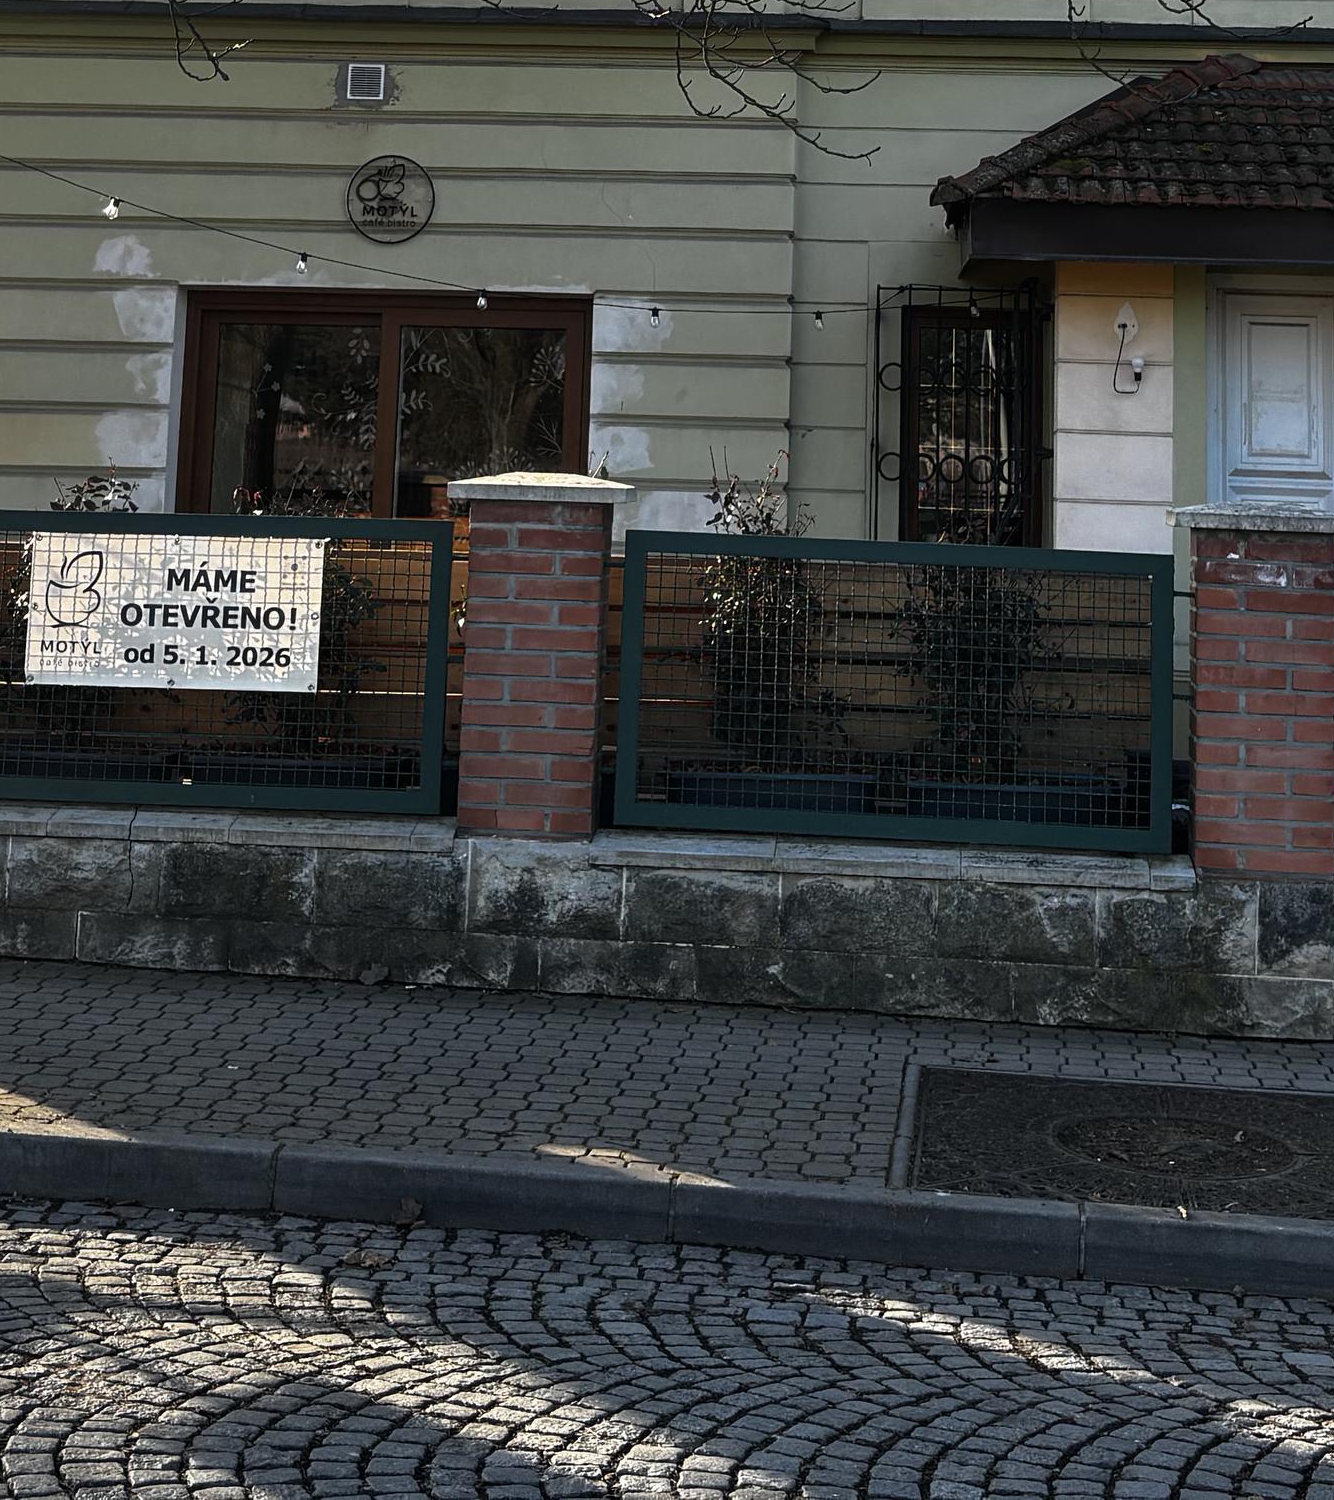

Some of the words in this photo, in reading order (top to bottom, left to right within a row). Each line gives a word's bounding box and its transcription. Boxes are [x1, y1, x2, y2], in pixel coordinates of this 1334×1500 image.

[362, 203, 418, 217] MOTÝL
[362, 217, 384, 227] café
[387, 219, 416, 227] bistro
[166, 560, 257, 593] MÁME
[120, 597, 297, 631] OTEVŘENO!
[40, 637, 102, 655] MOTÝL
[124, 644, 155, 664] od
[226, 646, 292, 667] 2026
